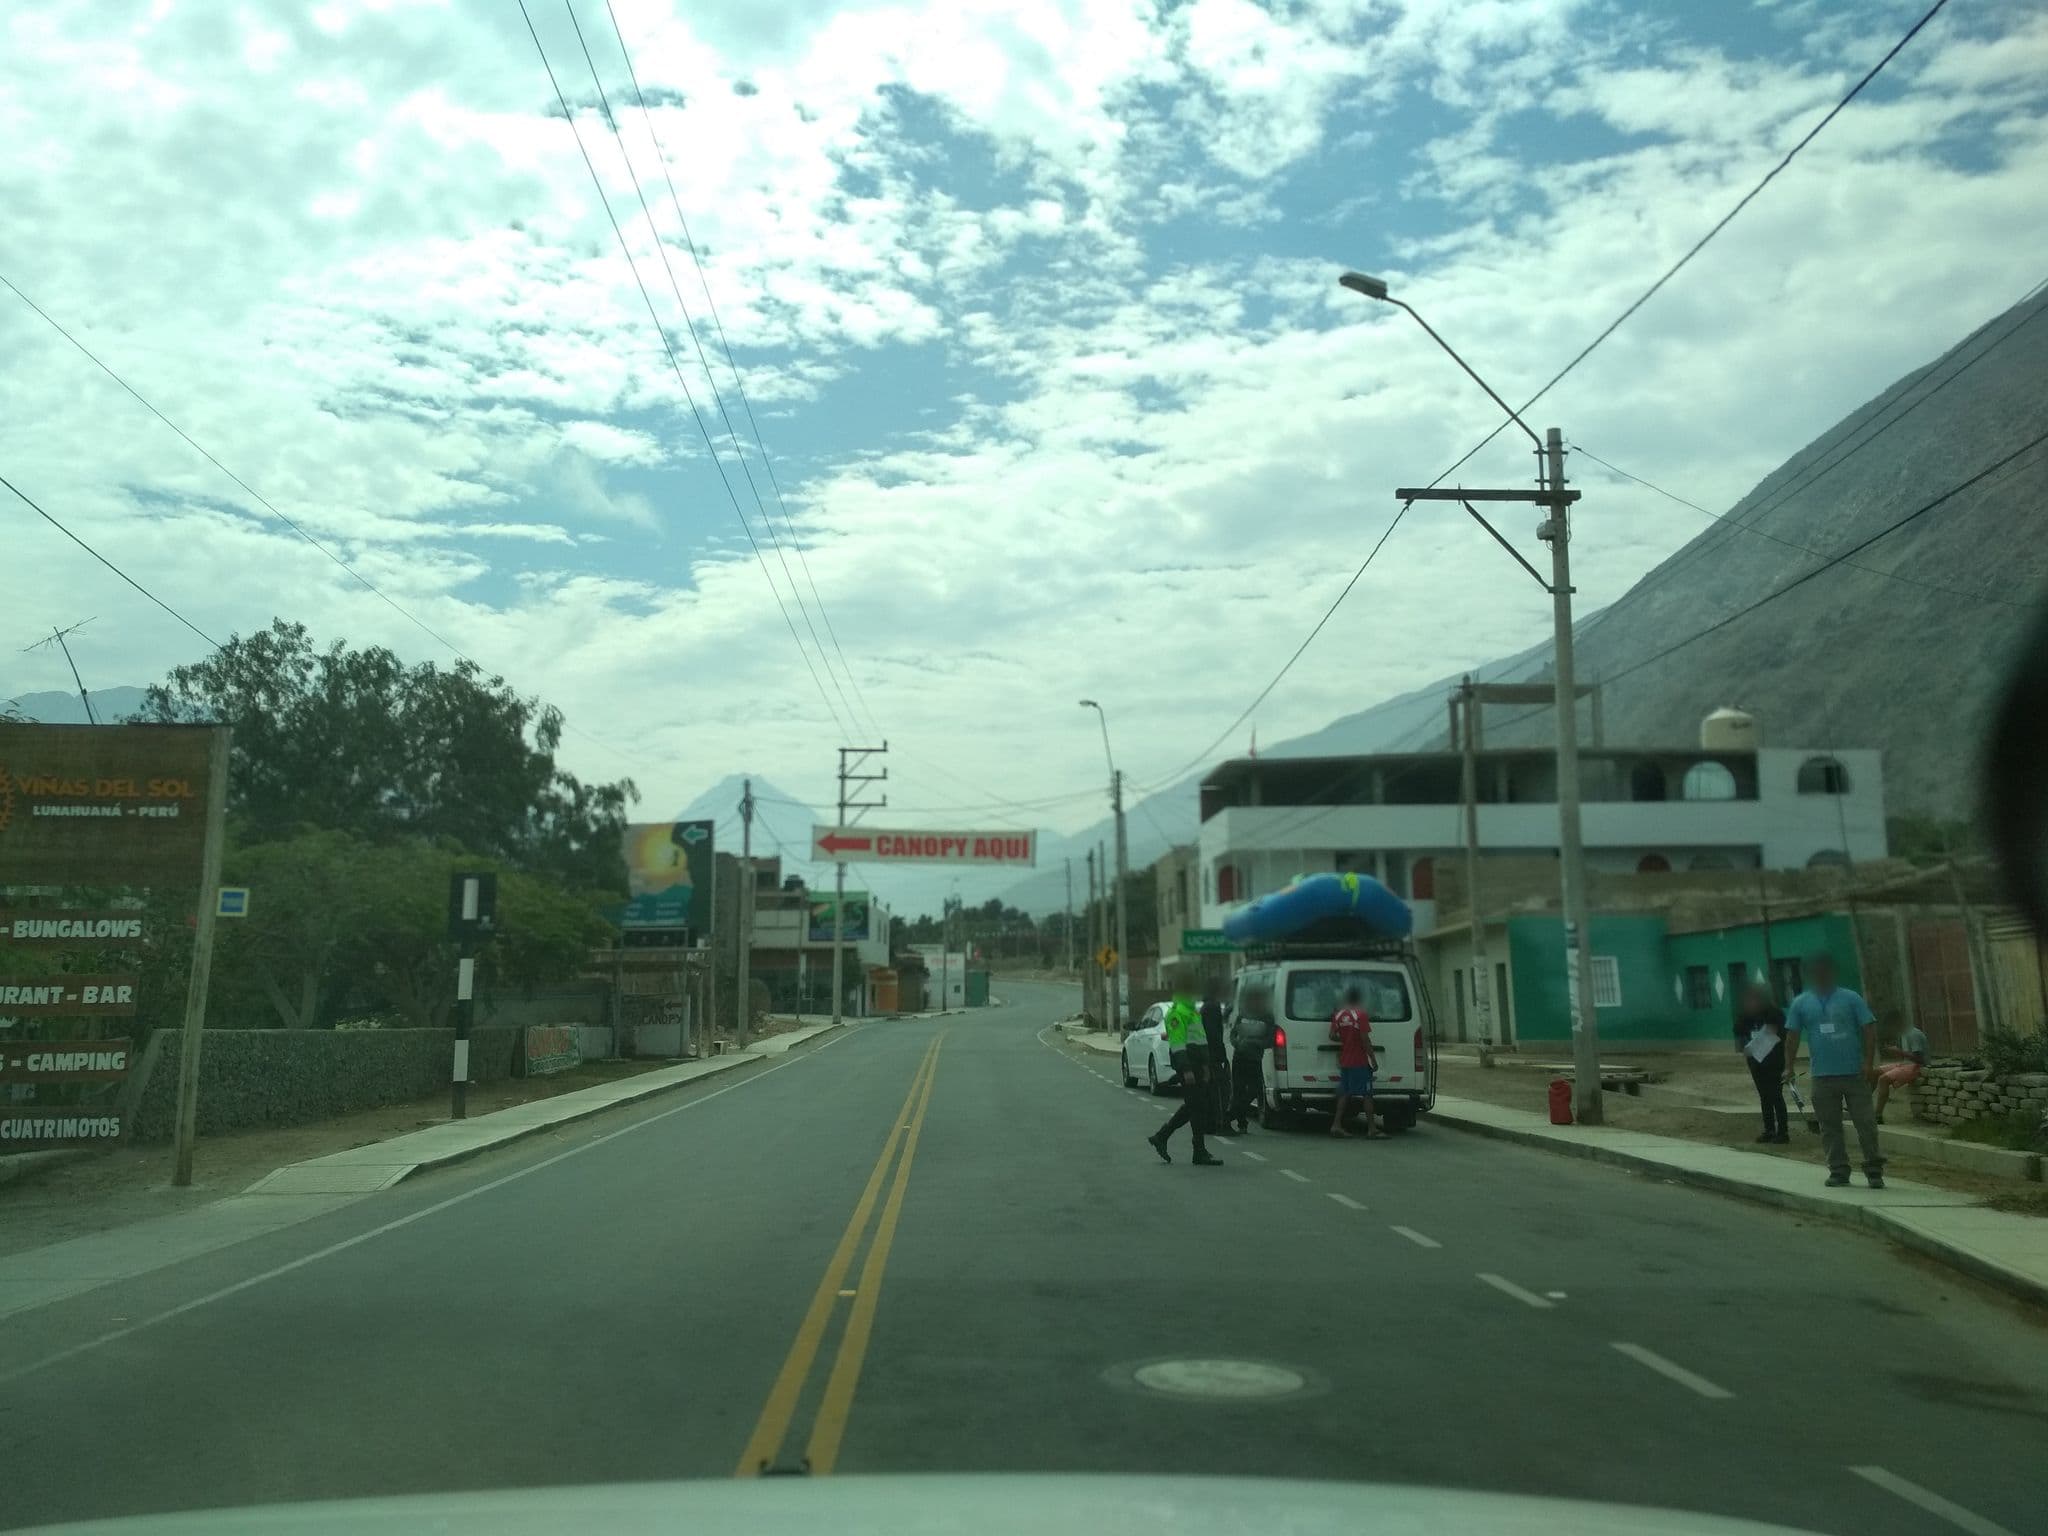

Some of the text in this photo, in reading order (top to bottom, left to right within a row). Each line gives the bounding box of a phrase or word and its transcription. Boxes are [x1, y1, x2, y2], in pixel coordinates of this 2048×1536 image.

[16, 776, 194, 797] VIÑAS DEL SOL
[33, 803, 122, 817] LUNAHUANÁ
[139, 803, 180, 817] PERÚ
[876, 835, 968, 857] CANOPY
[13, 920, 142, 938] BUNGALOWS
[82, 986, 132, 1004] BAR
[642, 1014, 681, 1025] CANOPY
[27, 1052, 126, 1071] CAMPING
[1, 1118, 120, 1139] CUATRIMOTOS
